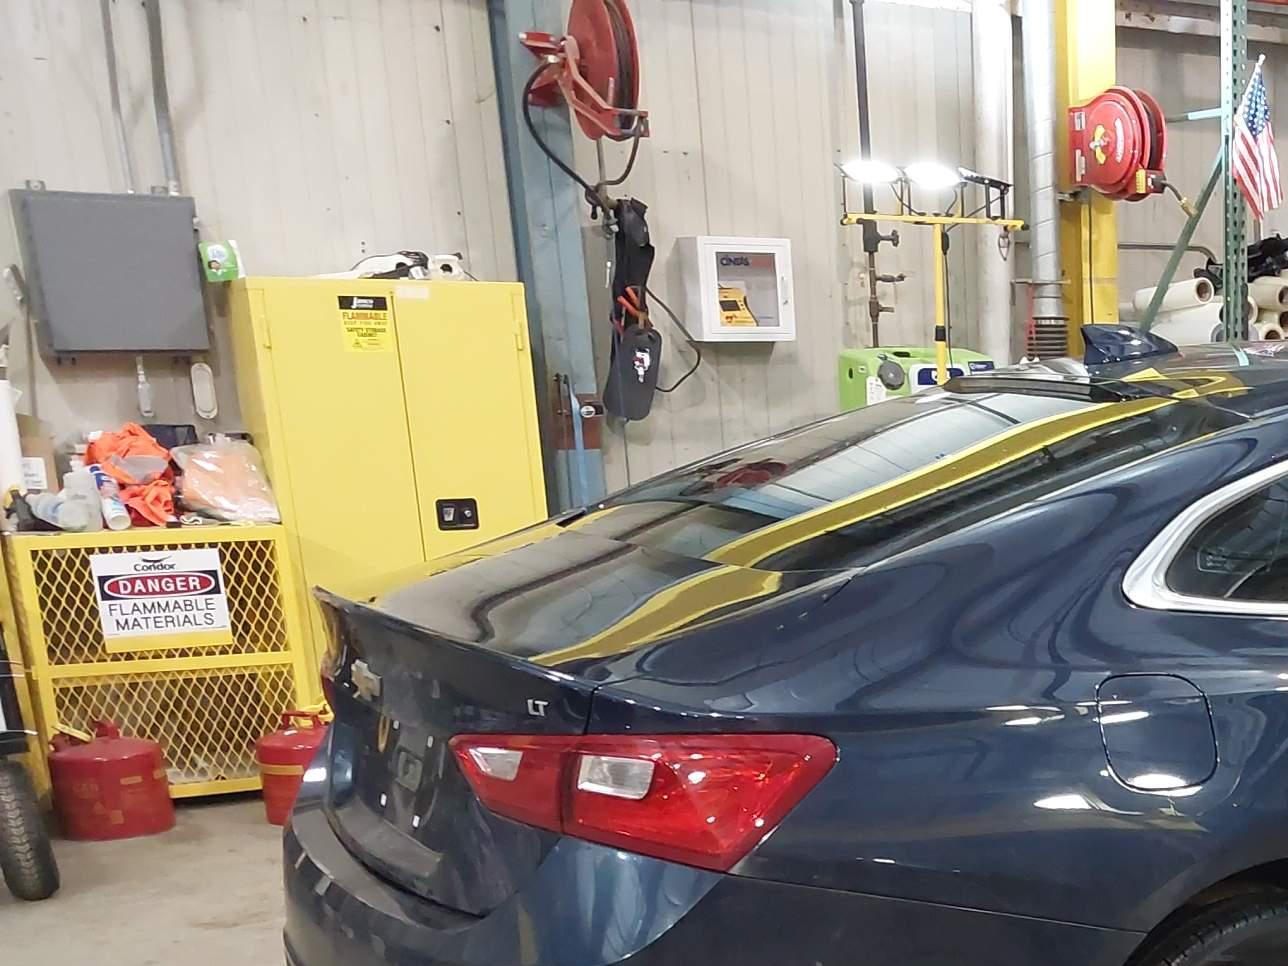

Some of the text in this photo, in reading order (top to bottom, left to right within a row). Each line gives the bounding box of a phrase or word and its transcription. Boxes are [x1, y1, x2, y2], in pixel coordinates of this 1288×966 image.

[133, 563, 176, 572] Condor
[119, 576, 201, 594] DANGER
[108, 597, 216, 617] FLAMMABLE
[115, 612, 215, 632] MATERIALS
[527, 699, 549, 717] LT
